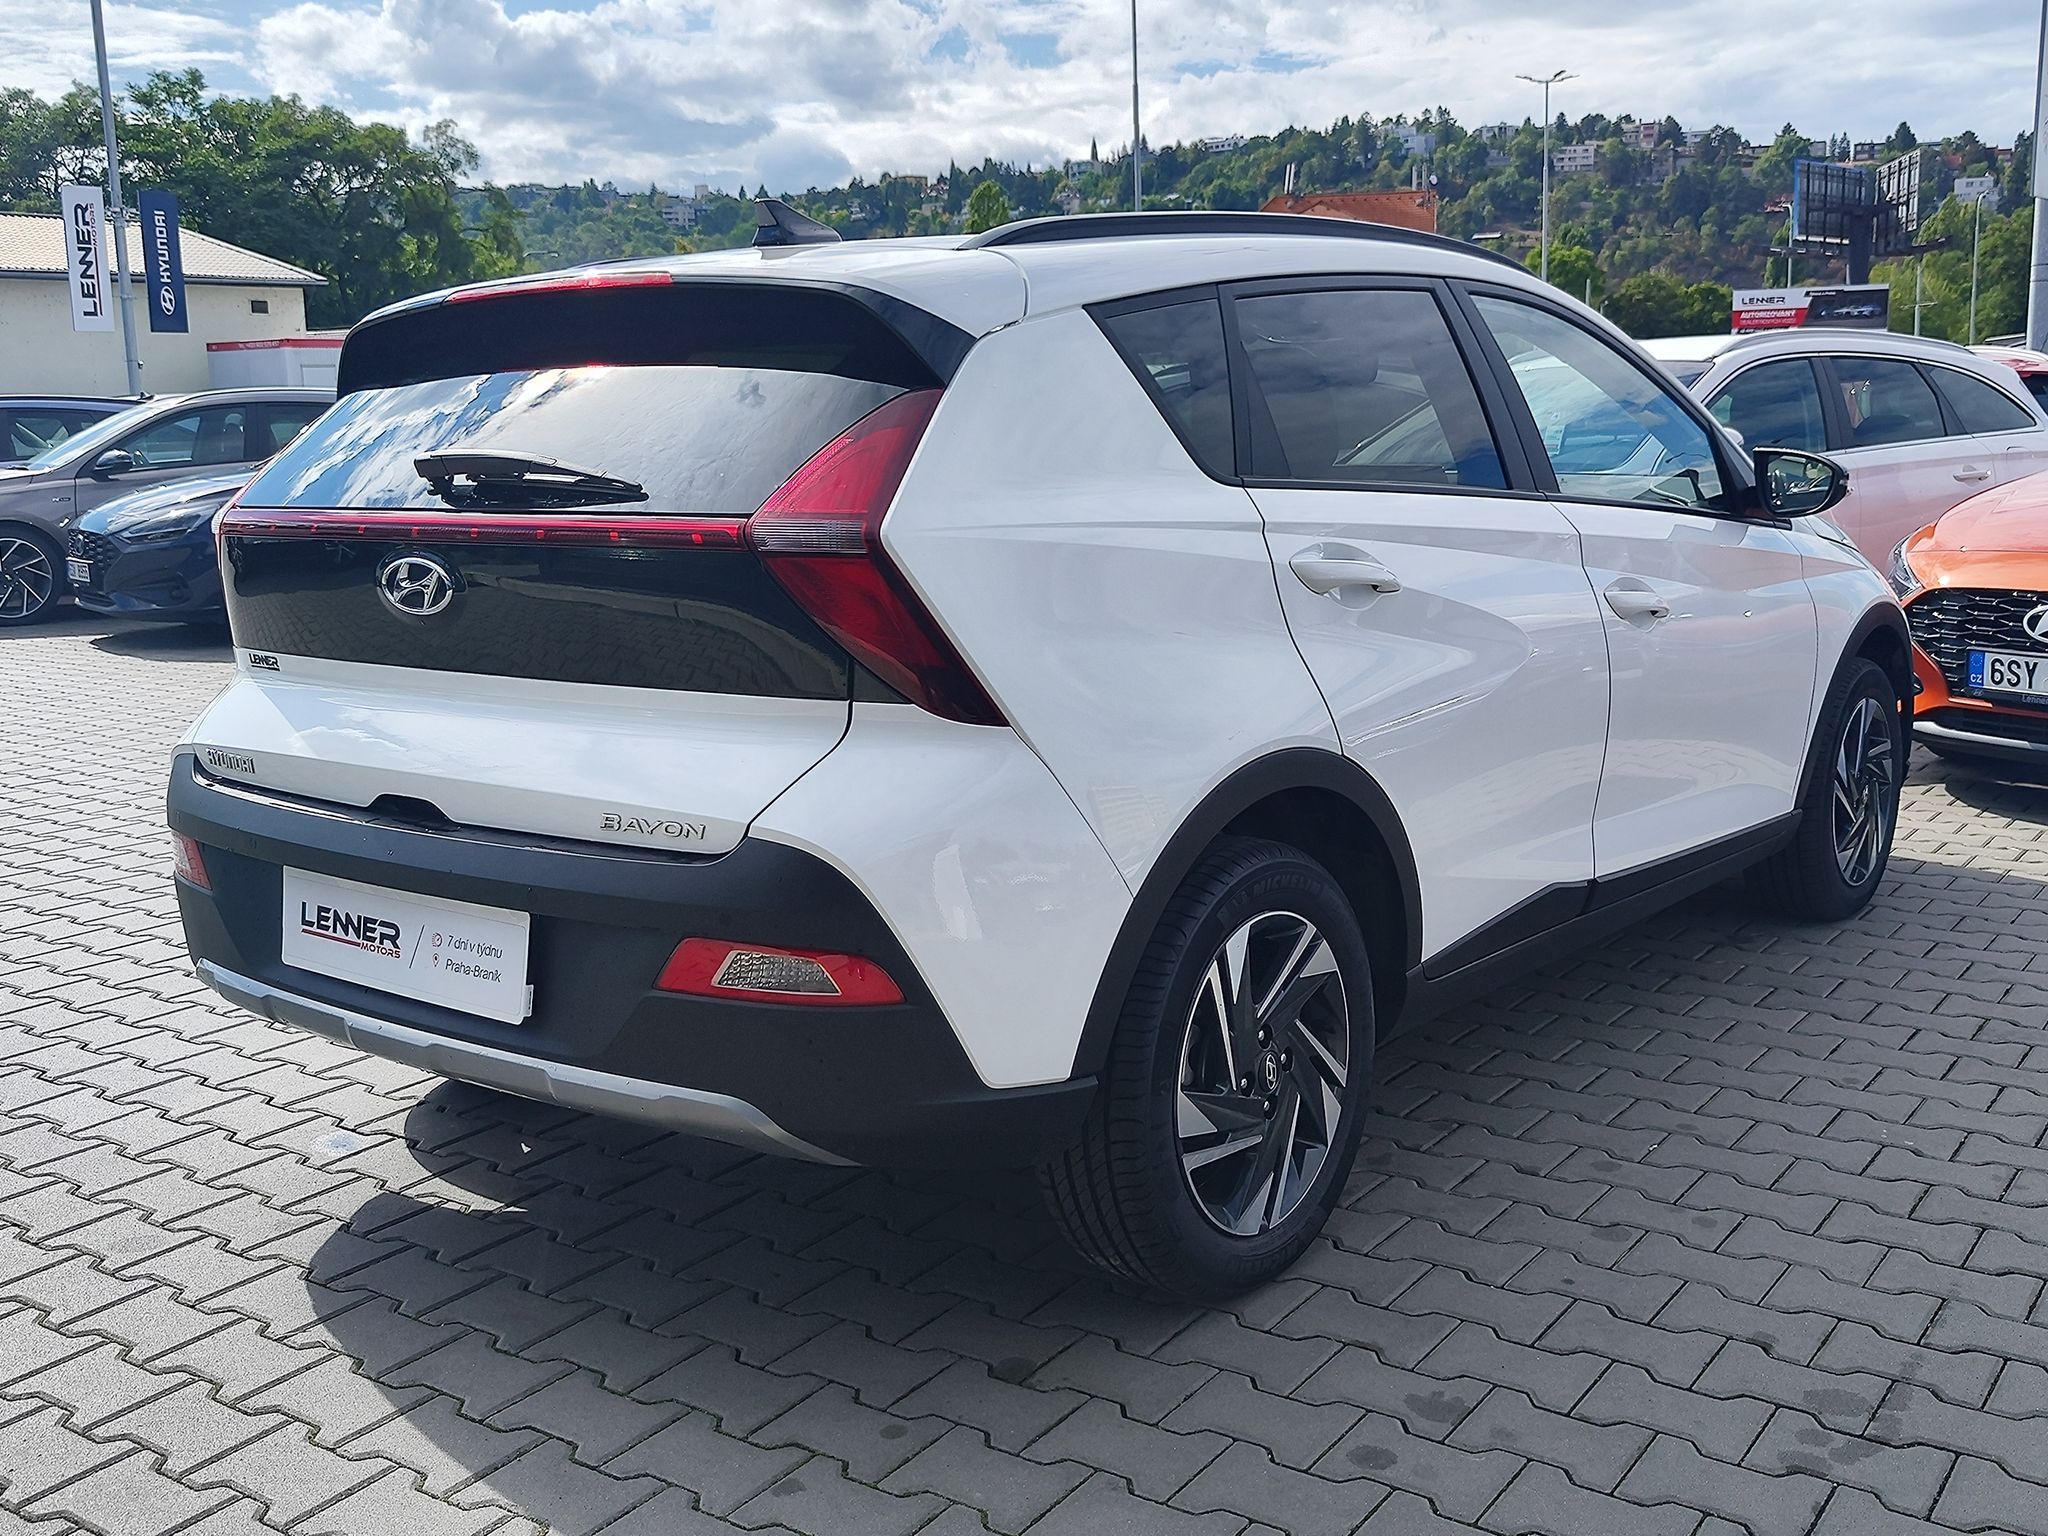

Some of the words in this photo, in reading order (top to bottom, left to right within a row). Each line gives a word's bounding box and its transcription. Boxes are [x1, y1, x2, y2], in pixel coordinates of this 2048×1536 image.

[89, 203, 98, 247] MOTORS
[74, 203, 98, 317] LENNER
[154, 210, 171, 283] HYUNDAI
[1741, 296, 1786, 305] LENNER
[248, 653, 280, 668] LENNER
[1990, 657, 2039, 689] 6SY
[1970, 673, 1982, 683] CZ
[205, 747, 255, 774] HYUNDAI
[599, 812, 707, 840] BAYON
[301, 901, 401, 949] LENNER
[360, 942, 401, 959] MOTORS
[447, 935, 454, 947] 7
[454, 938, 469, 950] dní
[469, 943, 476, 952] v
[477, 943, 503, 959] týdnu
[445, 958, 502, 983] Praha-Braník
